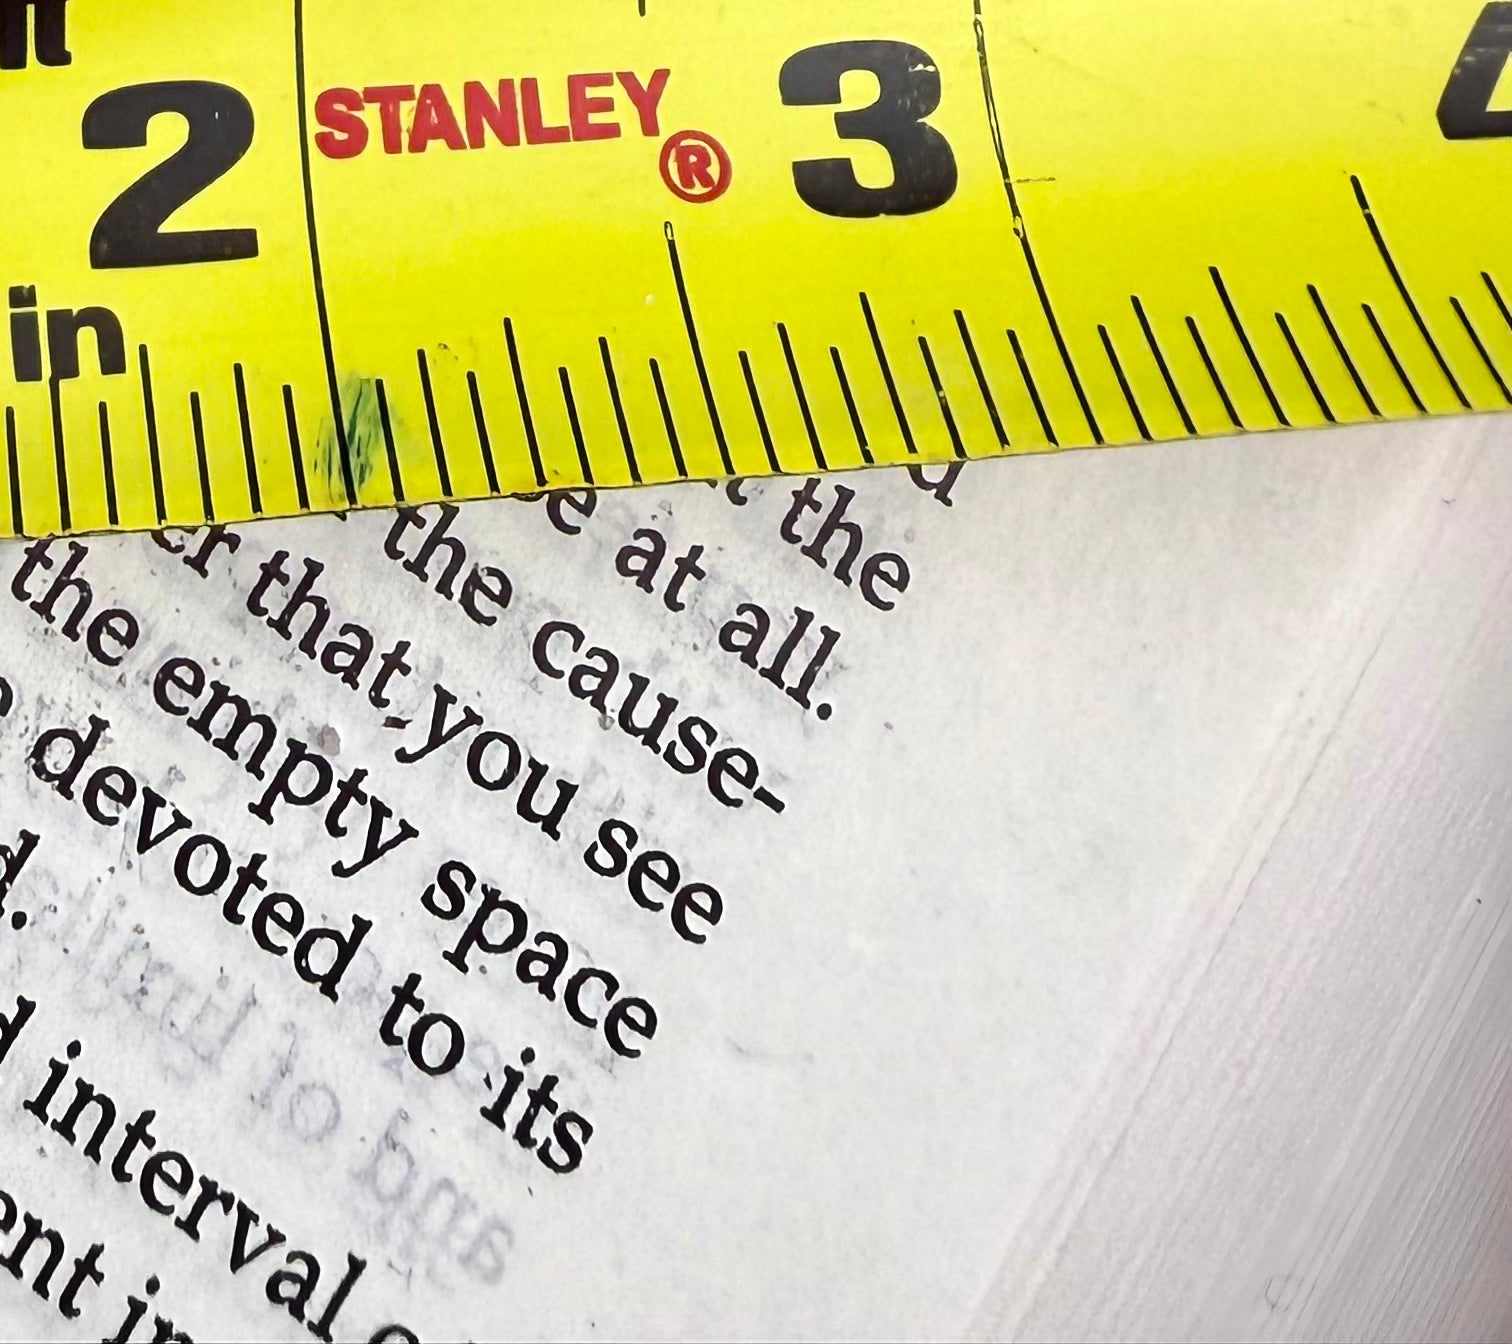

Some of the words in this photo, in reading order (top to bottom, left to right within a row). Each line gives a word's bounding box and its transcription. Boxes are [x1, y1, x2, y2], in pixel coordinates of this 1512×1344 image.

[82, 80, 258, 269] 2
[315, 69, 670, 159] STANLEY
[779, 40, 957, 218] 3
[9, 284, 128, 382] in
[615, 529, 706, 612] at
[719, 603, 840, 720] all.
[780, 478, 910, 611] the
[246, 550, 411, 709] that
[584, 819, 723, 944] see
[533, 620, 786, 814] cause-
[25, 714, 372, 1003] devoted
[379, 973, 465, 1076] to
[480, 1047, 593, 1174] its
[153, 658, 419, 878] empty
[421, 860, 657, 1058] space
[23, 1040, 367, 1344] interval
